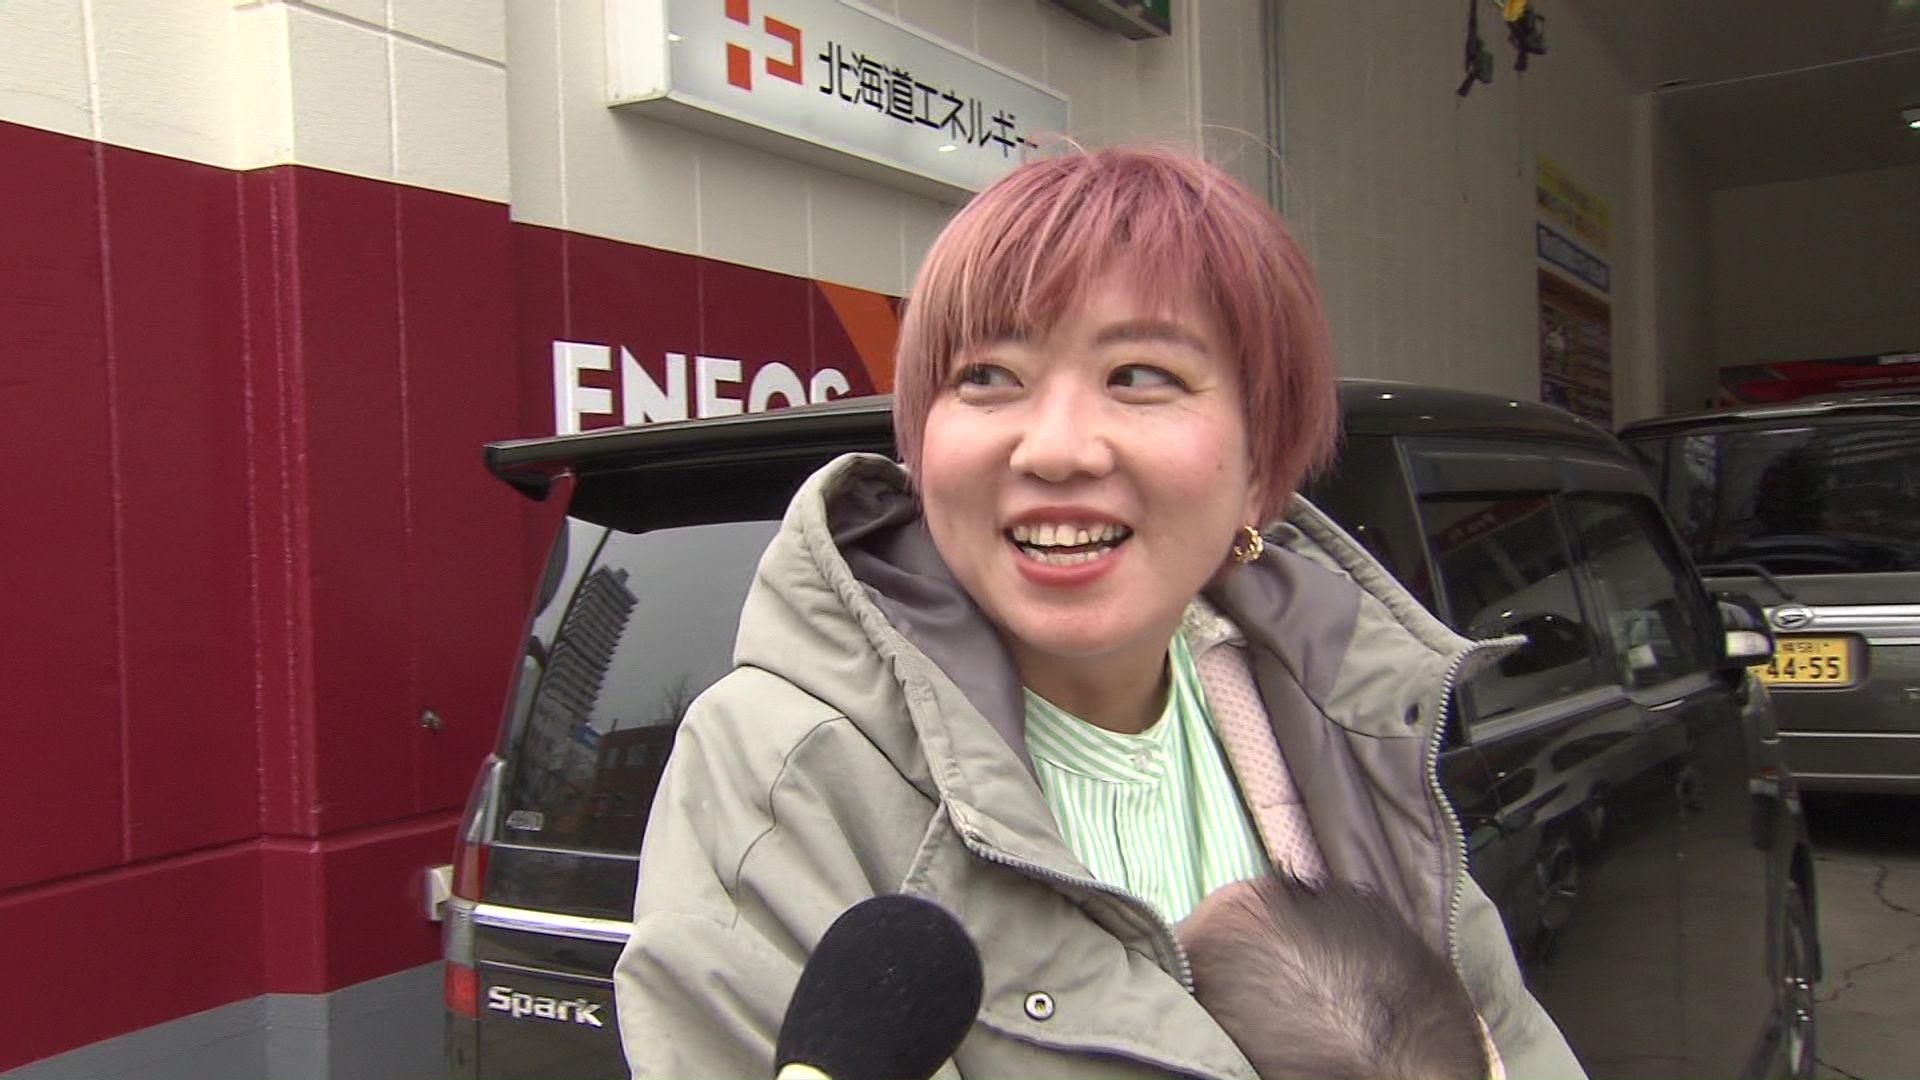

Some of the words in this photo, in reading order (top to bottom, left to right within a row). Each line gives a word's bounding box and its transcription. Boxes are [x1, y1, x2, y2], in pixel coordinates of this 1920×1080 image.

[819, 40, 1038, 158] 北海道エネルギー
[1766, 656, 1841, 679] 44-55
[487, 985, 603, 1028] Spark
